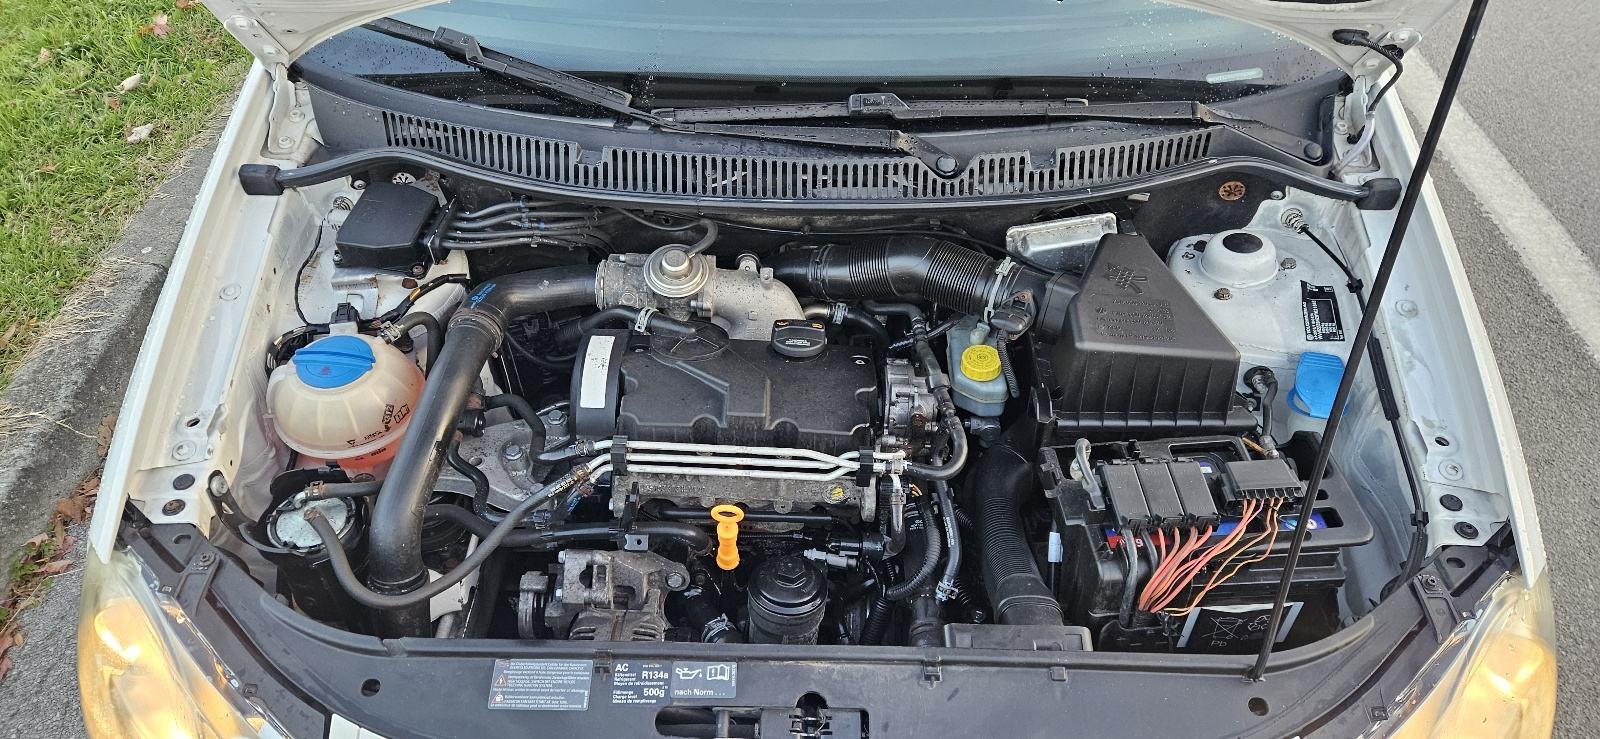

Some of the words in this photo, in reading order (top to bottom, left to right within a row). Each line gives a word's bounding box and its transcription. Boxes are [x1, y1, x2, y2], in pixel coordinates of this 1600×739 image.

[616, 664, 628, 672] AC
[642, 670, 668, 680] R134a
[643, 687, 665, 698] 500g
[674, 688, 692, 696] nach
